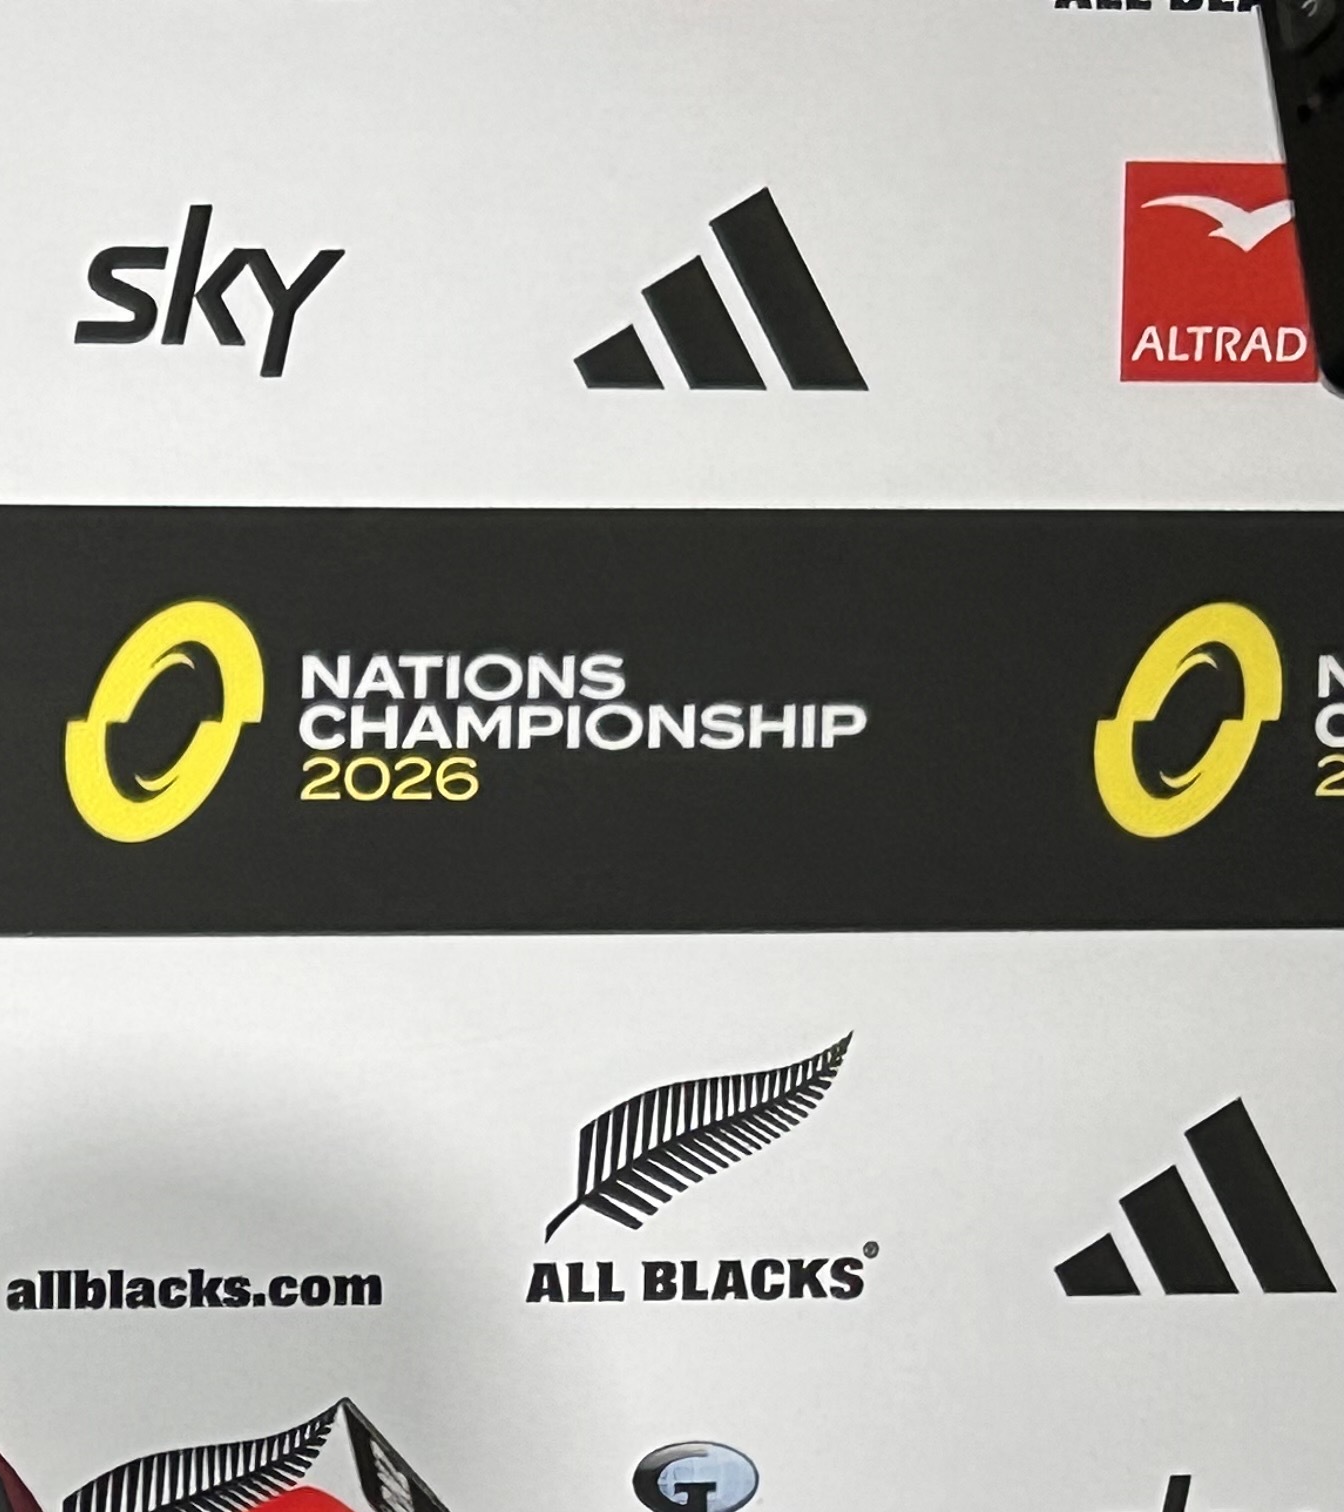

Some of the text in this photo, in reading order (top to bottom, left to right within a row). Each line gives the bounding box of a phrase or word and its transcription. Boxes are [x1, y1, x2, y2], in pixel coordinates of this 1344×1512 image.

[73, 203, 346, 378] sky
[1131, 325, 1308, 363] ALTRAD
[301, 653, 626, 702] NATIONS
[298, 703, 868, 751] CHAMPIONSHIP
[300, 756, 479, 801] 2026
[6, 1268, 383, 1311] allblacks.com
[525, 1256, 865, 1303] ALL BLACKS
